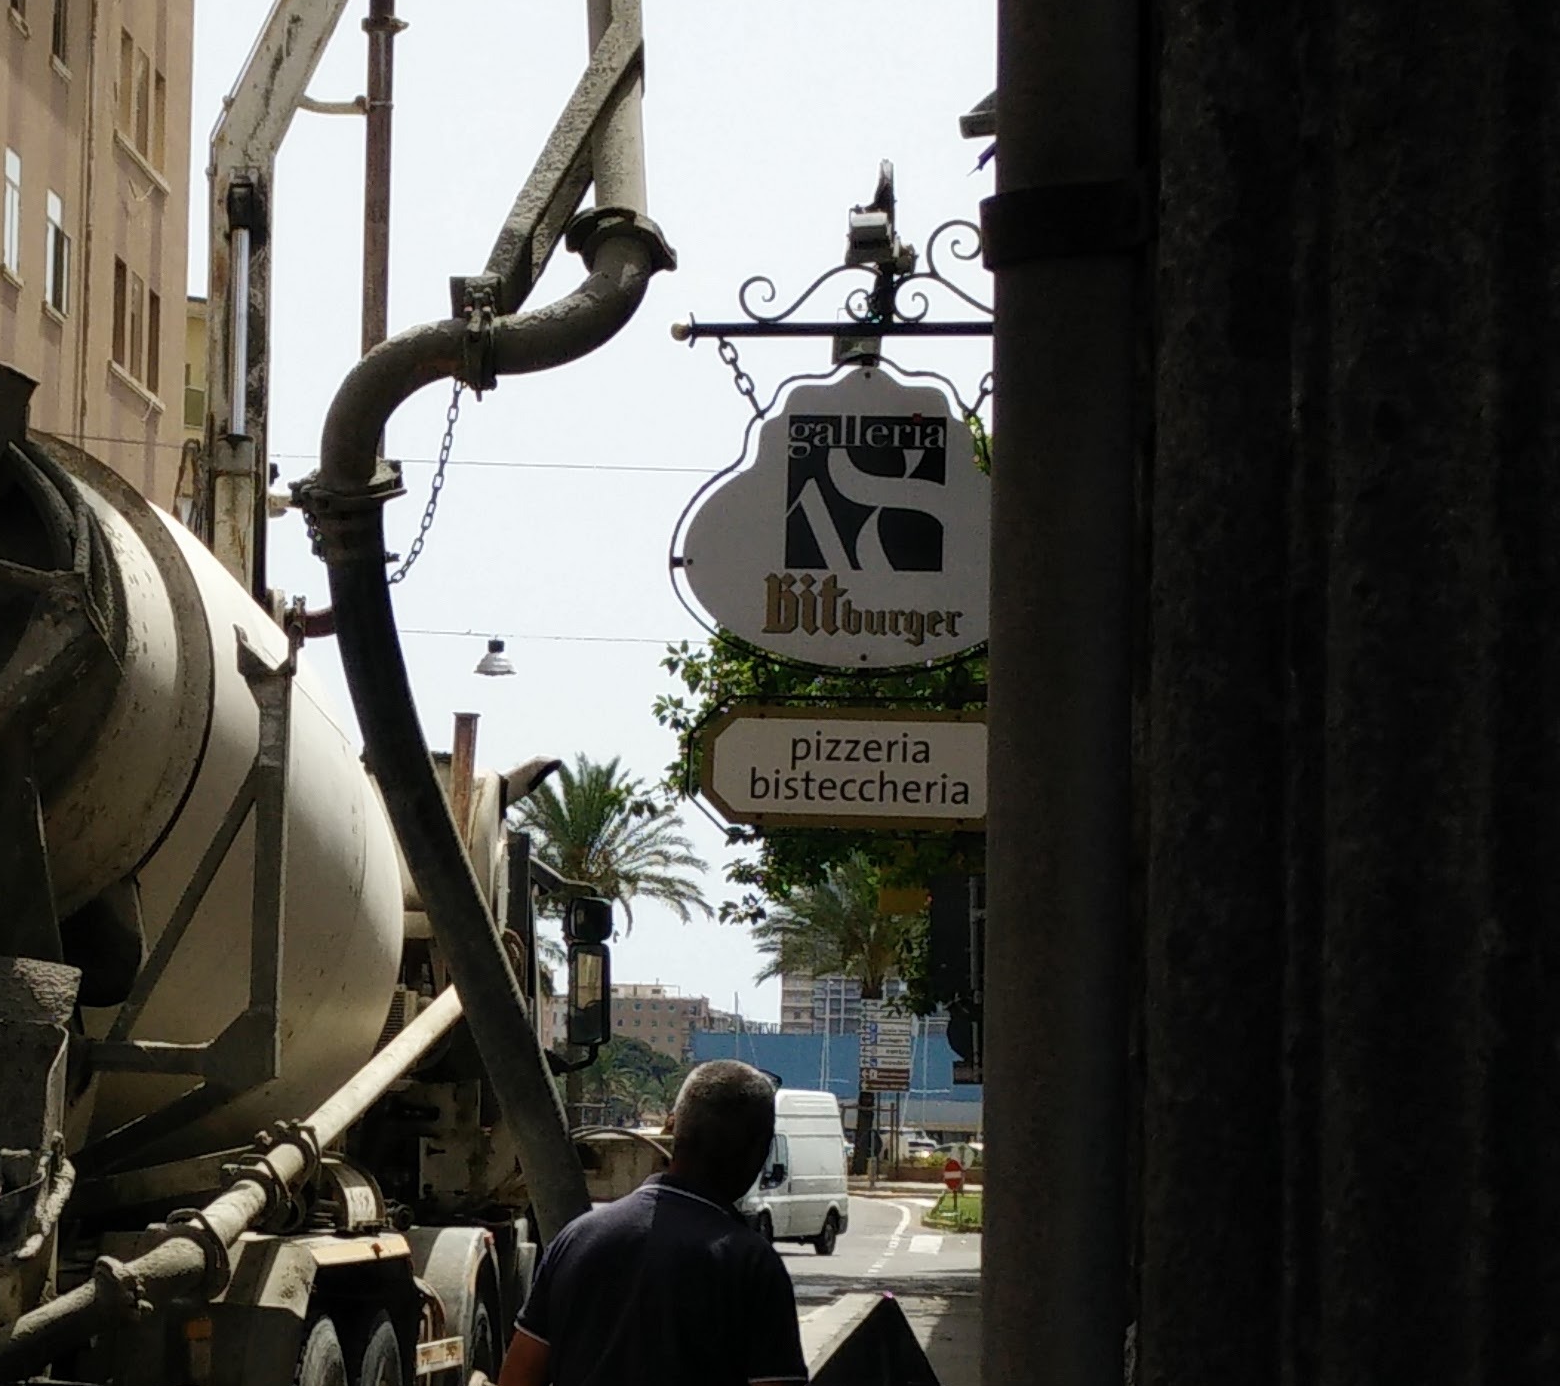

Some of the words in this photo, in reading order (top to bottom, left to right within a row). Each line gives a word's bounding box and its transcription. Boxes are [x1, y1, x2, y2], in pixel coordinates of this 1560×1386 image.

[787, 415, 946, 458] galleria
[762, 573, 964, 646] Bitburger
[790, 732, 931, 770] pizzeria
[750, 767, 970, 805] bisteccheria
